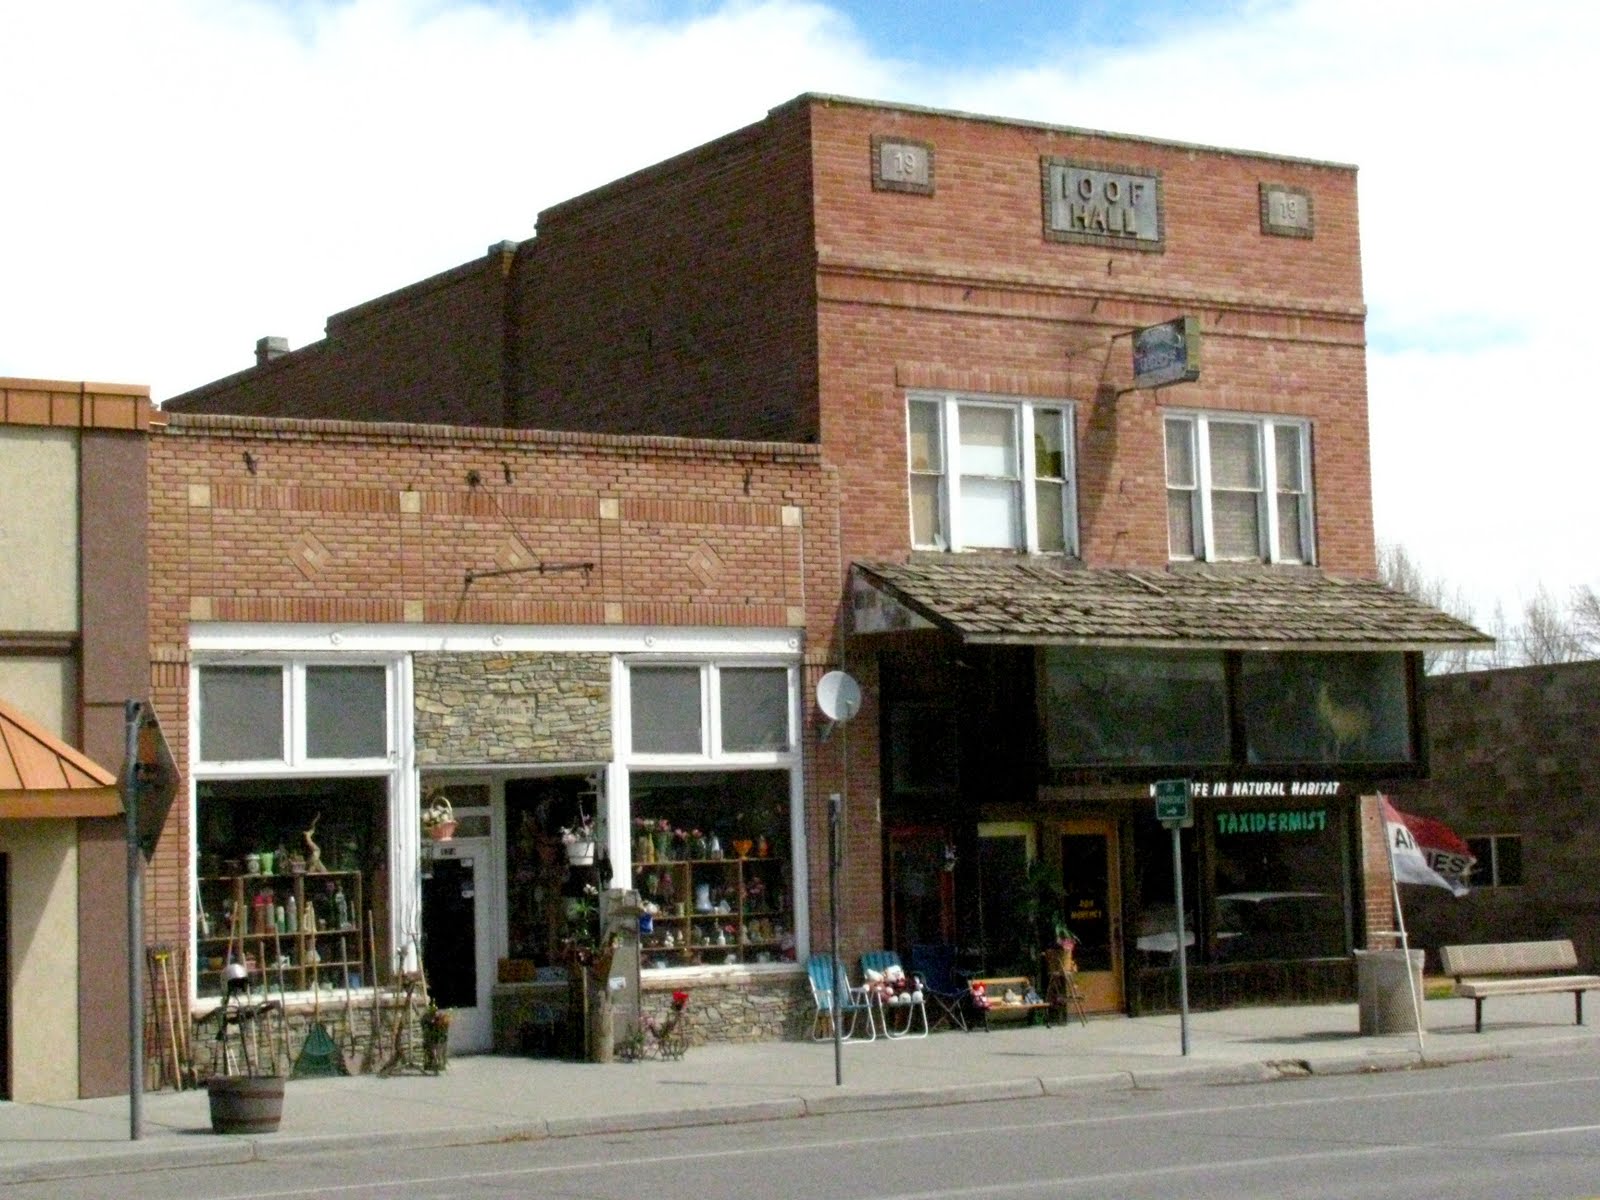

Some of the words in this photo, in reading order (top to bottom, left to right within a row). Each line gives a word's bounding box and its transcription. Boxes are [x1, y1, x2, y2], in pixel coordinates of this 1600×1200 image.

[894, 152, 915, 175] 19
[1070, 202, 1138, 236] HALL
[1280, 199, 1297, 220] 19
[1213, 782, 1227, 797] IN
[1232, 782, 1286, 797] NATURAL
[1291, 781, 1340, 796] HABITAT
[1216, 811, 1327, 834] TAXIDERMIST
